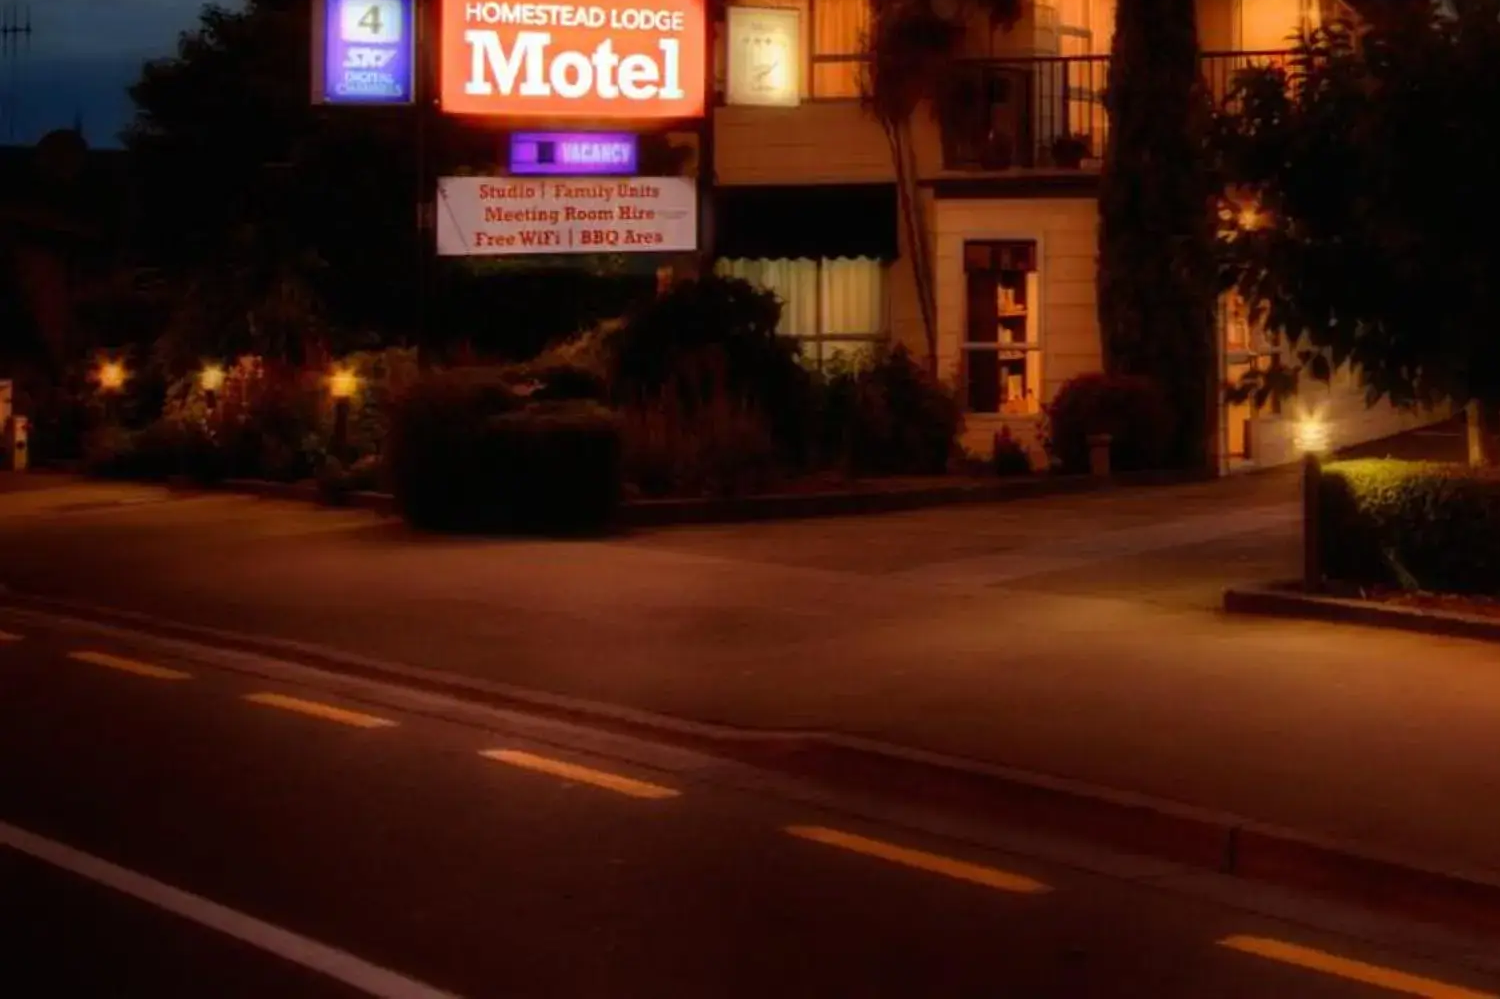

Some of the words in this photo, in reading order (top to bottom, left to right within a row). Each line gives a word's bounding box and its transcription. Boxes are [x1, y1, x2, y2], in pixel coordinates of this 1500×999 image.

[358, 5, 384, 34] 4
[465, 2, 605, 27] HOMESTEAD
[611, 9, 685, 31] LODGE
[464, 30, 685, 99] Motel
[562, 142, 631, 163] VACANCY
[479, 184, 535, 199] Studio
[554, 183, 612, 201] Family
[617, 183, 660, 198] Units
[485, 206, 559, 224] Meeting
[564, 207, 614, 221] Room
[618, 206, 655, 220] Hire
[474, 232, 516, 247] Free
[519, 231, 561, 246] WiFi
[580, 230, 619, 247] BBQ
[623, 229, 664, 244] Area
